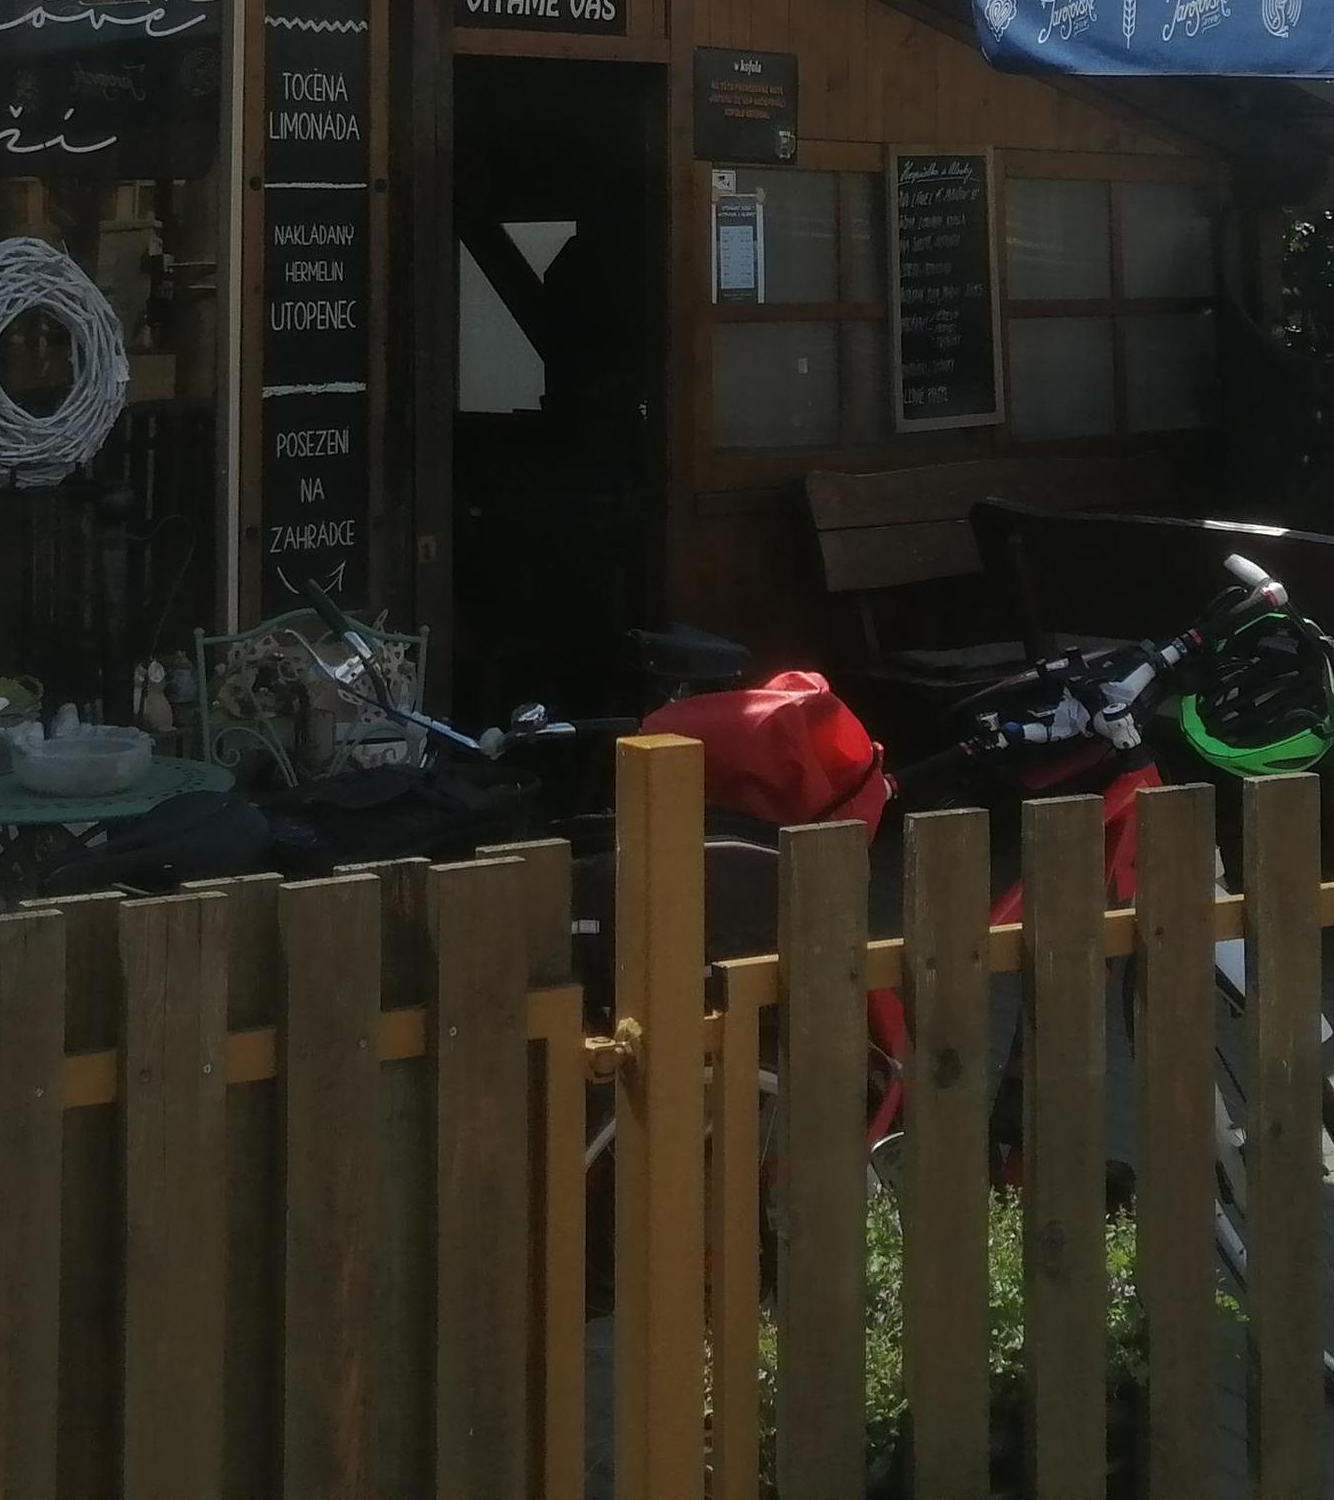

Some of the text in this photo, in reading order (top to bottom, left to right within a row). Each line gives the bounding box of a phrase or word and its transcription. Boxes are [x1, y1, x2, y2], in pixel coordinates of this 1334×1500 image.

[269, 110, 360, 141] LIMONÁDA
[271, 300, 357, 331] UTOPENEC
[276, 426, 349, 459] POSEZENÍ
[300, 476, 325, 504] NA
[269, 519, 356, 553] ZAHRÁDCE
